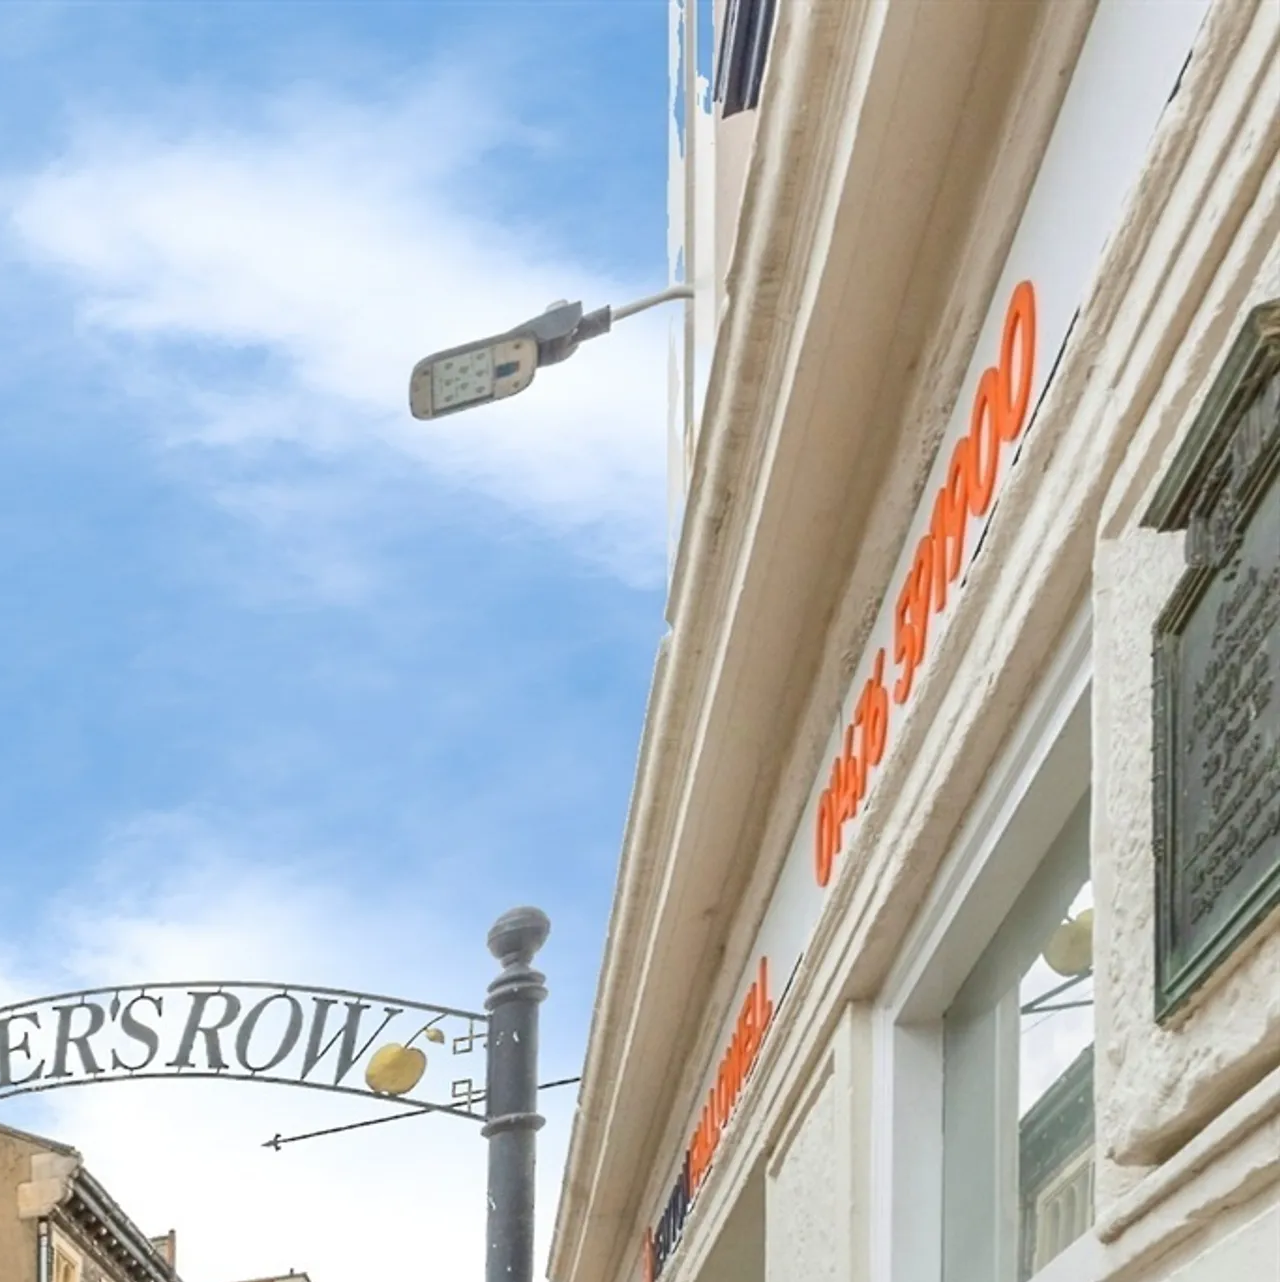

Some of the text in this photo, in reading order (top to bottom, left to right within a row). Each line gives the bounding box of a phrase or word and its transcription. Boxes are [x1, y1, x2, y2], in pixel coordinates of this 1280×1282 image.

[815, 280, 1037, 887] 01476 591900
[165, 991, 403, 1086] ROW
